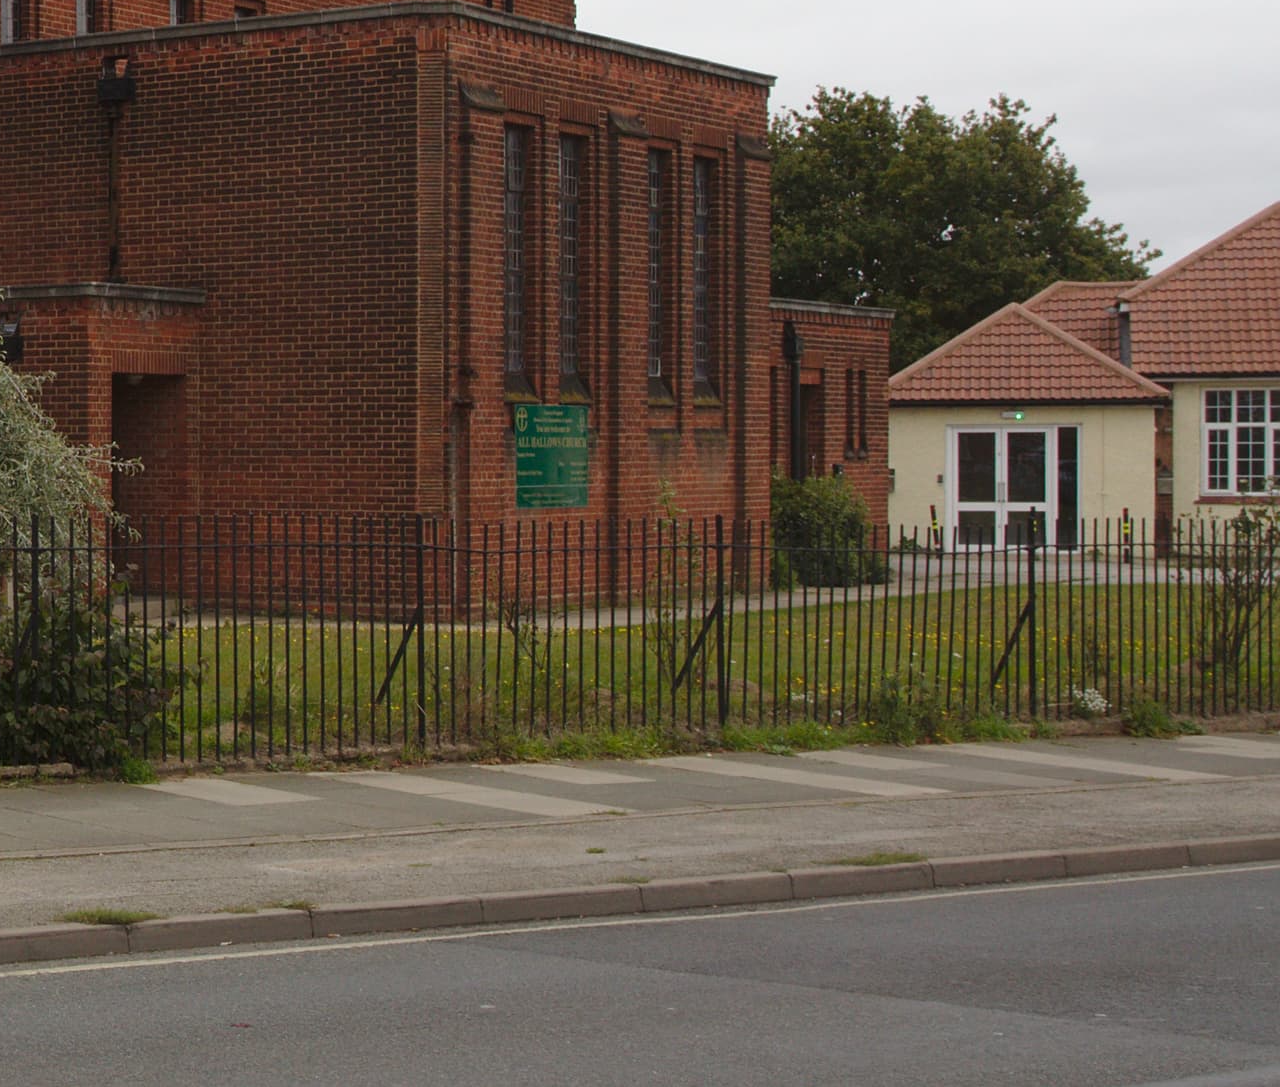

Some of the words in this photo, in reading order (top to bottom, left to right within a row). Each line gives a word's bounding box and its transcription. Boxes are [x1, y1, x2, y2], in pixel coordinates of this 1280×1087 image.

[518, 437, 531, 448] ALL
[531, 437, 561, 448] HALLOWS
[562, 437, 587, 448] CHURCH
